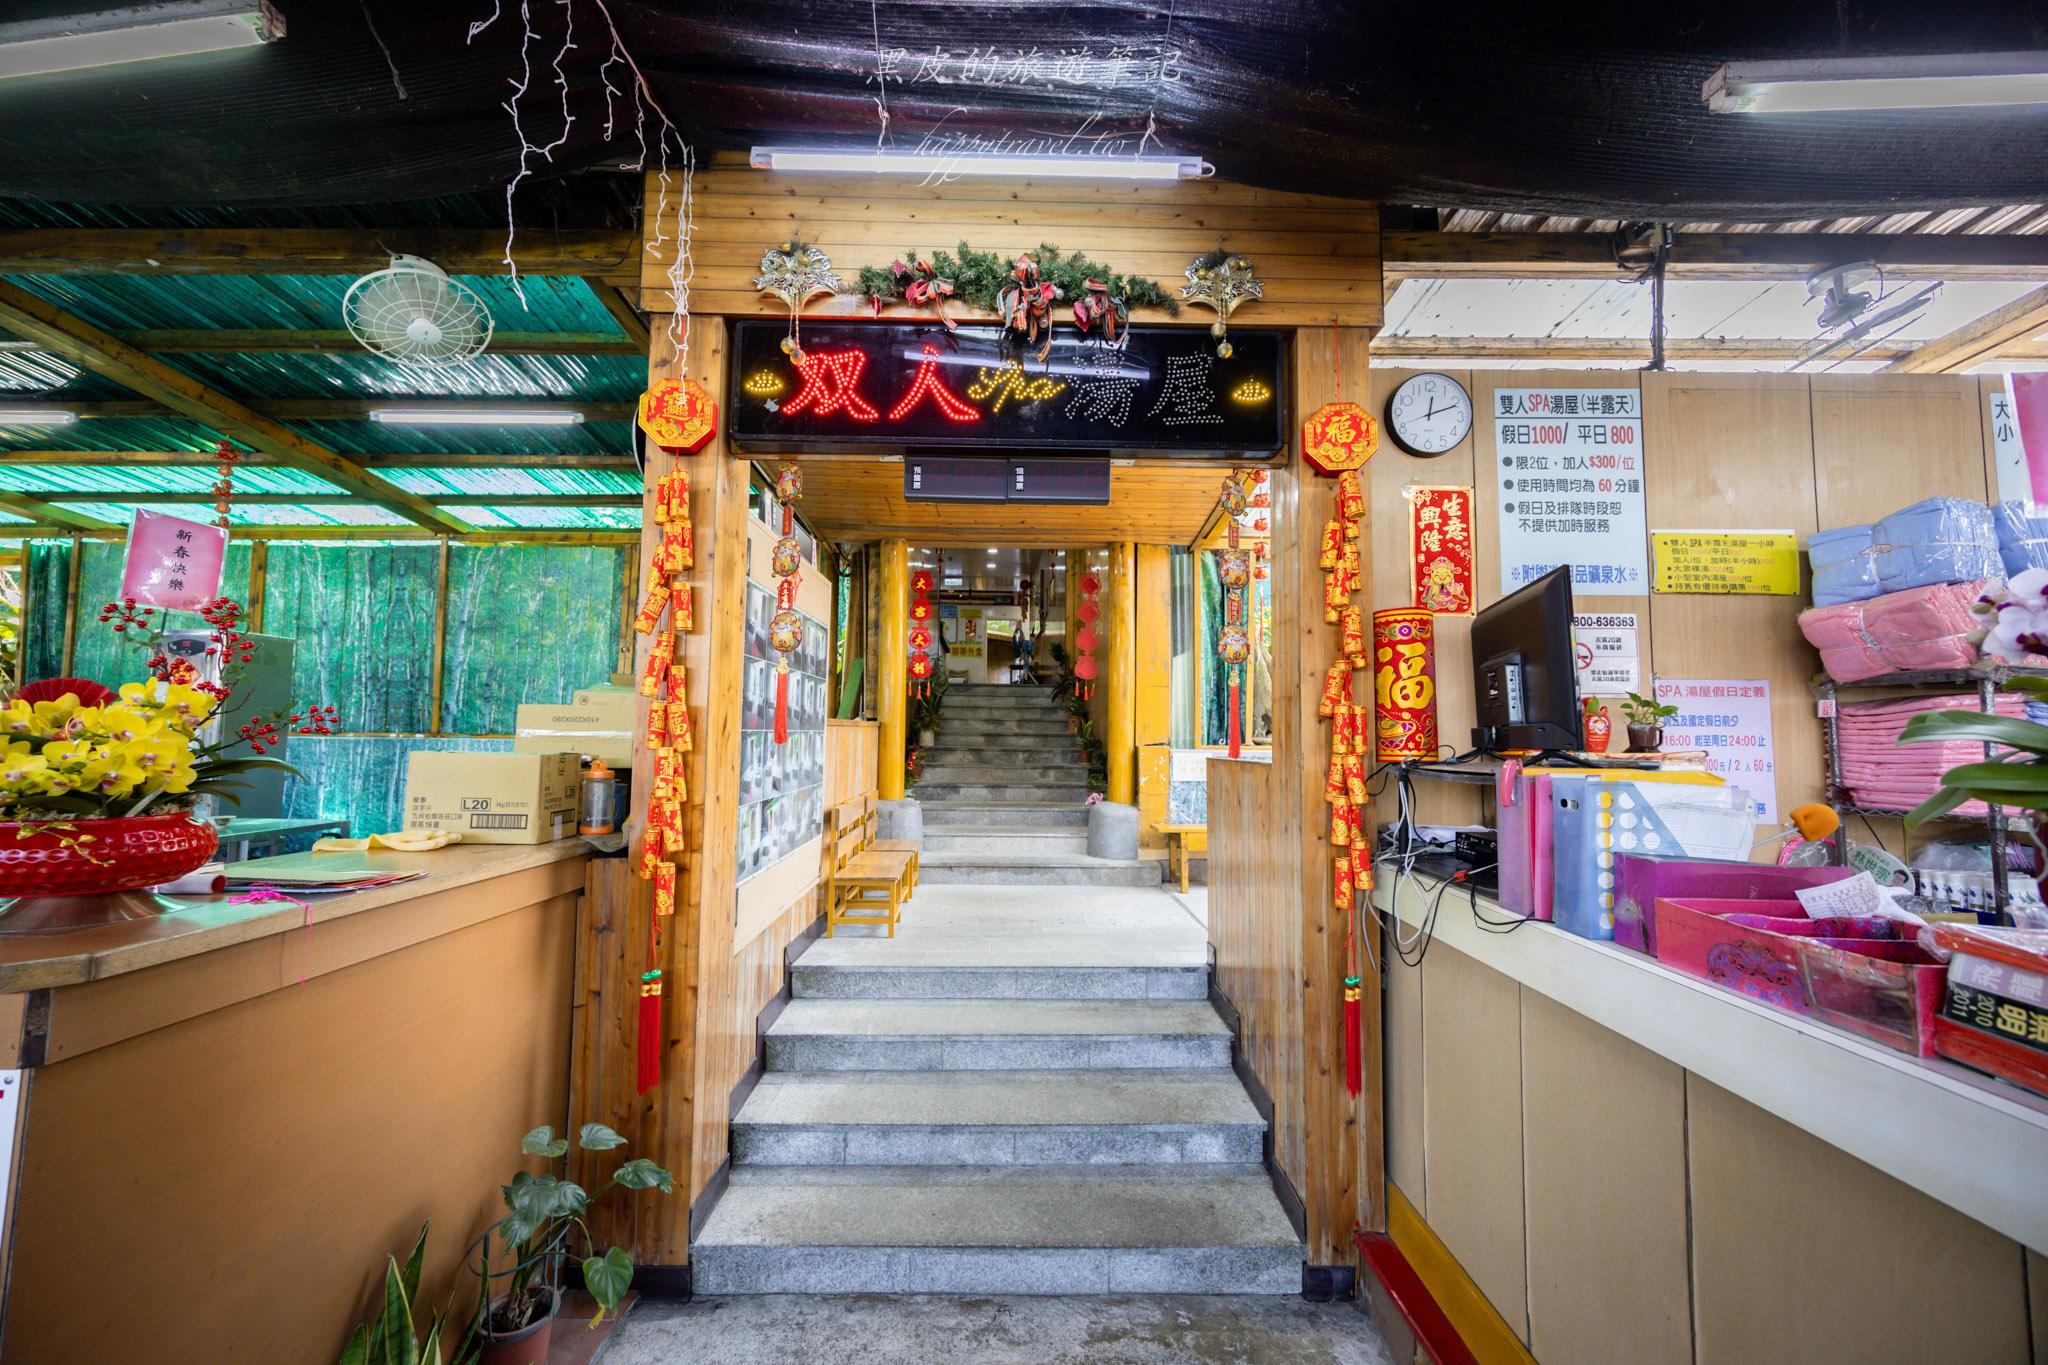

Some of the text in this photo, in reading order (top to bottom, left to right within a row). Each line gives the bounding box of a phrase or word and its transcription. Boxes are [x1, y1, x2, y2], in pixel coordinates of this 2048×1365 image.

[1517, 478, 1595, 493] 使用時間均為
[1518, 501, 1622, 515] 假日及排隊時段恕
[1518, 518, 1610, 533] 不提供加時服務
[168, 528, 193, 591] 新春快樂
[1375, 641, 1435, 711] 福
[1658, 684, 1682, 698] SPA
[463, 799, 490, 811] L20
